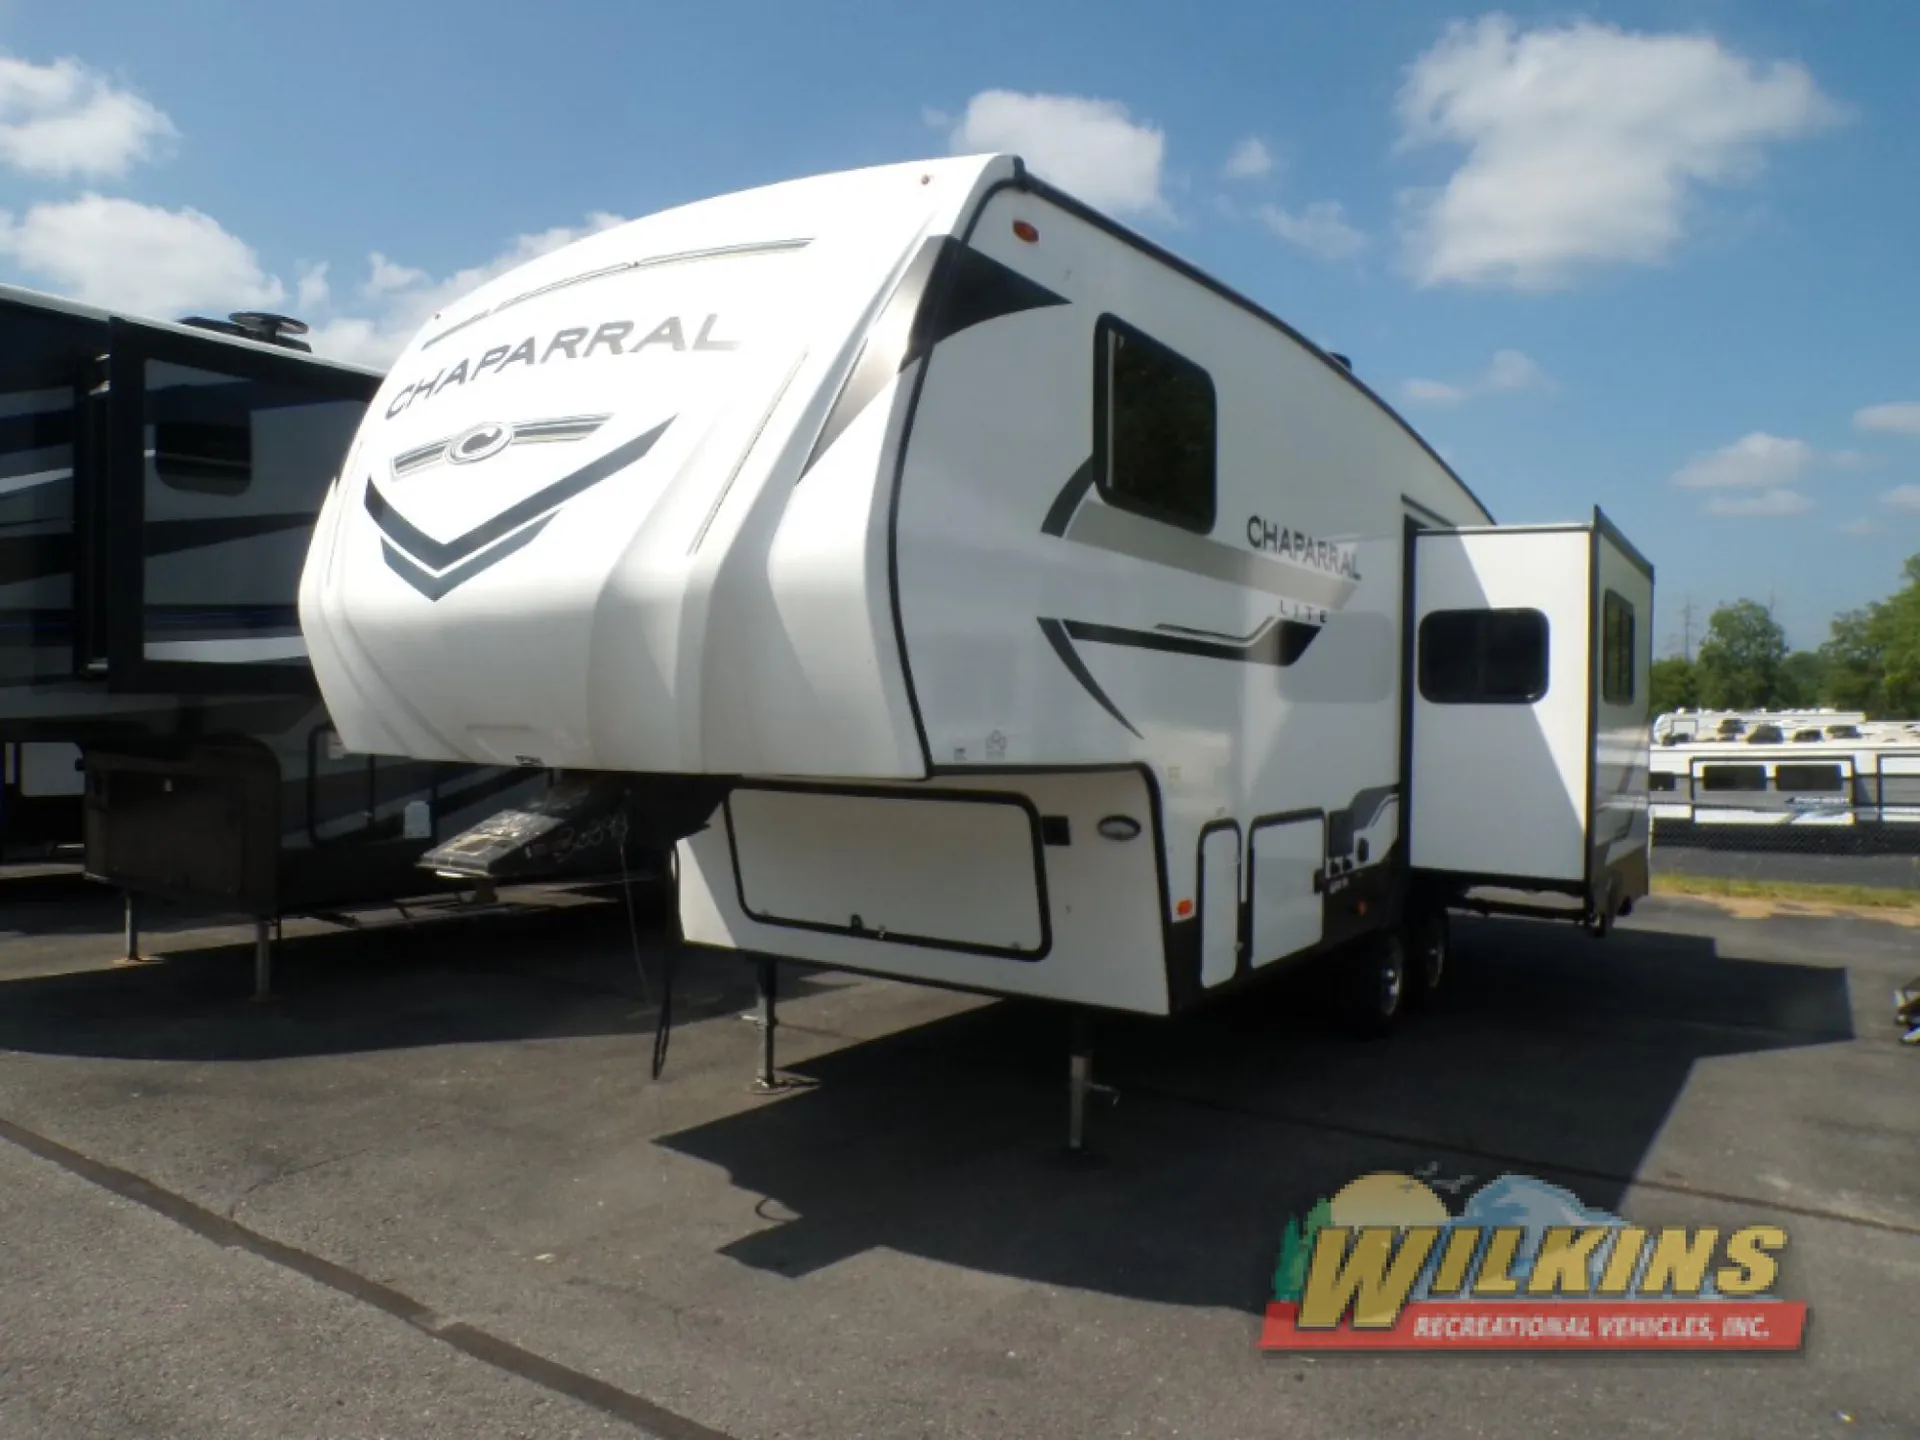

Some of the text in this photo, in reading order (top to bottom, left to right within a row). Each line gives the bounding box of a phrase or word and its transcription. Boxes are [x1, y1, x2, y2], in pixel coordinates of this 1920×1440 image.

[385, 312, 740, 420] CHAPARRAL
[1247, 514, 1362, 581] CHAPARRAL
[1279, 599, 1328, 623] LITE
